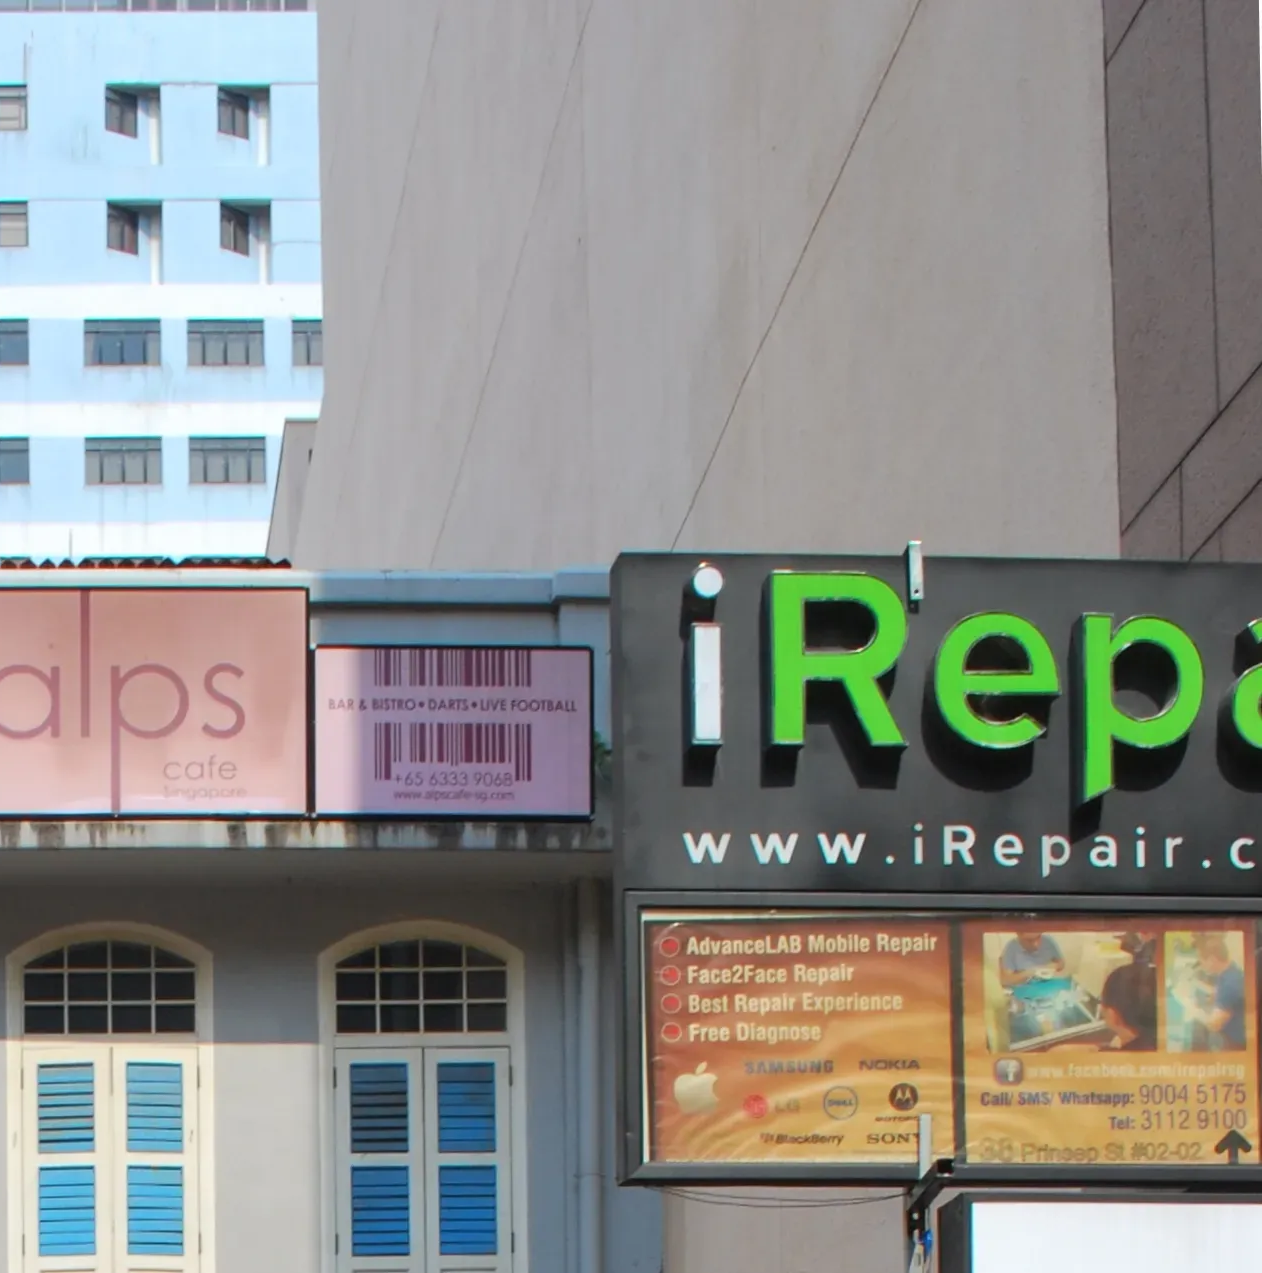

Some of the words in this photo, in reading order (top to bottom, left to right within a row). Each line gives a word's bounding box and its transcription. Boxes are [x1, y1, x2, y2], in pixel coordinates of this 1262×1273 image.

[691, 561, 1262, 802] iRep
[328, 698, 354, 711] BAR
[358, 699, 367, 711] &
[372, 699, 416, 711] BISTRO
[428, 699, 469, 711] DARTS
[480, 699, 507, 712] LIVE
[511, 699, 577, 712] FOOTBALL
[163, 753, 238, 781] cafe
[395, 771, 424, 787] +65
[429, 771, 469, 787] 6333
[473, 771, 513, 787] 9068
[686, 935, 802, 955] AdvanceLAB
[808, 934, 871, 953] Mobile
[876, 933, 938, 955] Repair
[687, 965, 787, 984] Face2Face
[793, 963, 854, 985] Repair
[688, 994, 729, 1013] Best
[734, 993, 796, 1015] Repair
[802, 992, 903, 1014] Experience
[688, 1024, 730, 1042] Free
[736, 1022, 822, 1044] Diagnose
[744, 1060, 834, 1074] SAMSUNG
[859, 1059, 921, 1071] NOKIA
[981, 1091, 1014, 1106] Call/
[1058, 1091, 1135, 1108] Whatsapp:
[1139, 1083, 1189, 1105] 9004
[1196, 1083, 1247, 1104] 5175
[1109, 1116, 1136, 1130] Tel:
[1141, 1109, 1190, 1131] 3112
[1197, 1108, 1247, 1130] 9100
[775, 1133, 844, 1146] BlackBerry
